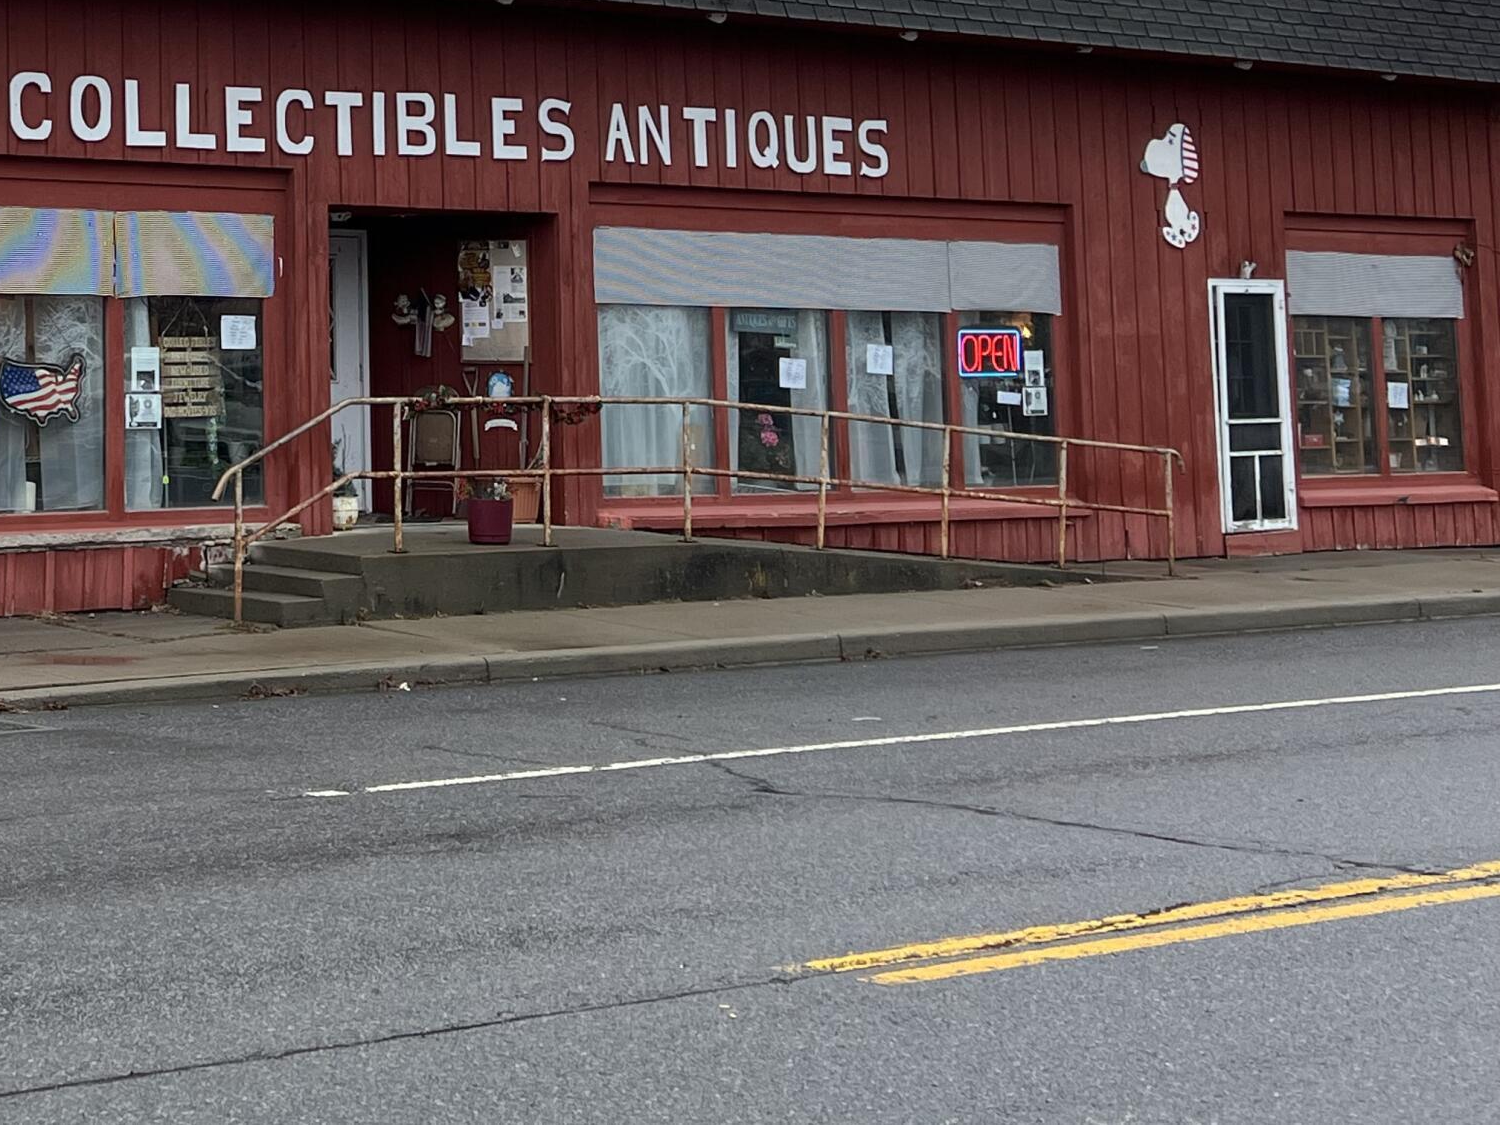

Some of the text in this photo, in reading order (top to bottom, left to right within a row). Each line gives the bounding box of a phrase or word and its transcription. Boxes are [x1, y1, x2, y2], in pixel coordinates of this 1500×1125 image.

[10, 72, 574, 161] COLLECTIBLES
[606, 104, 888, 177] ANTIQUES
[961, 334, 1017, 372] OPEN
